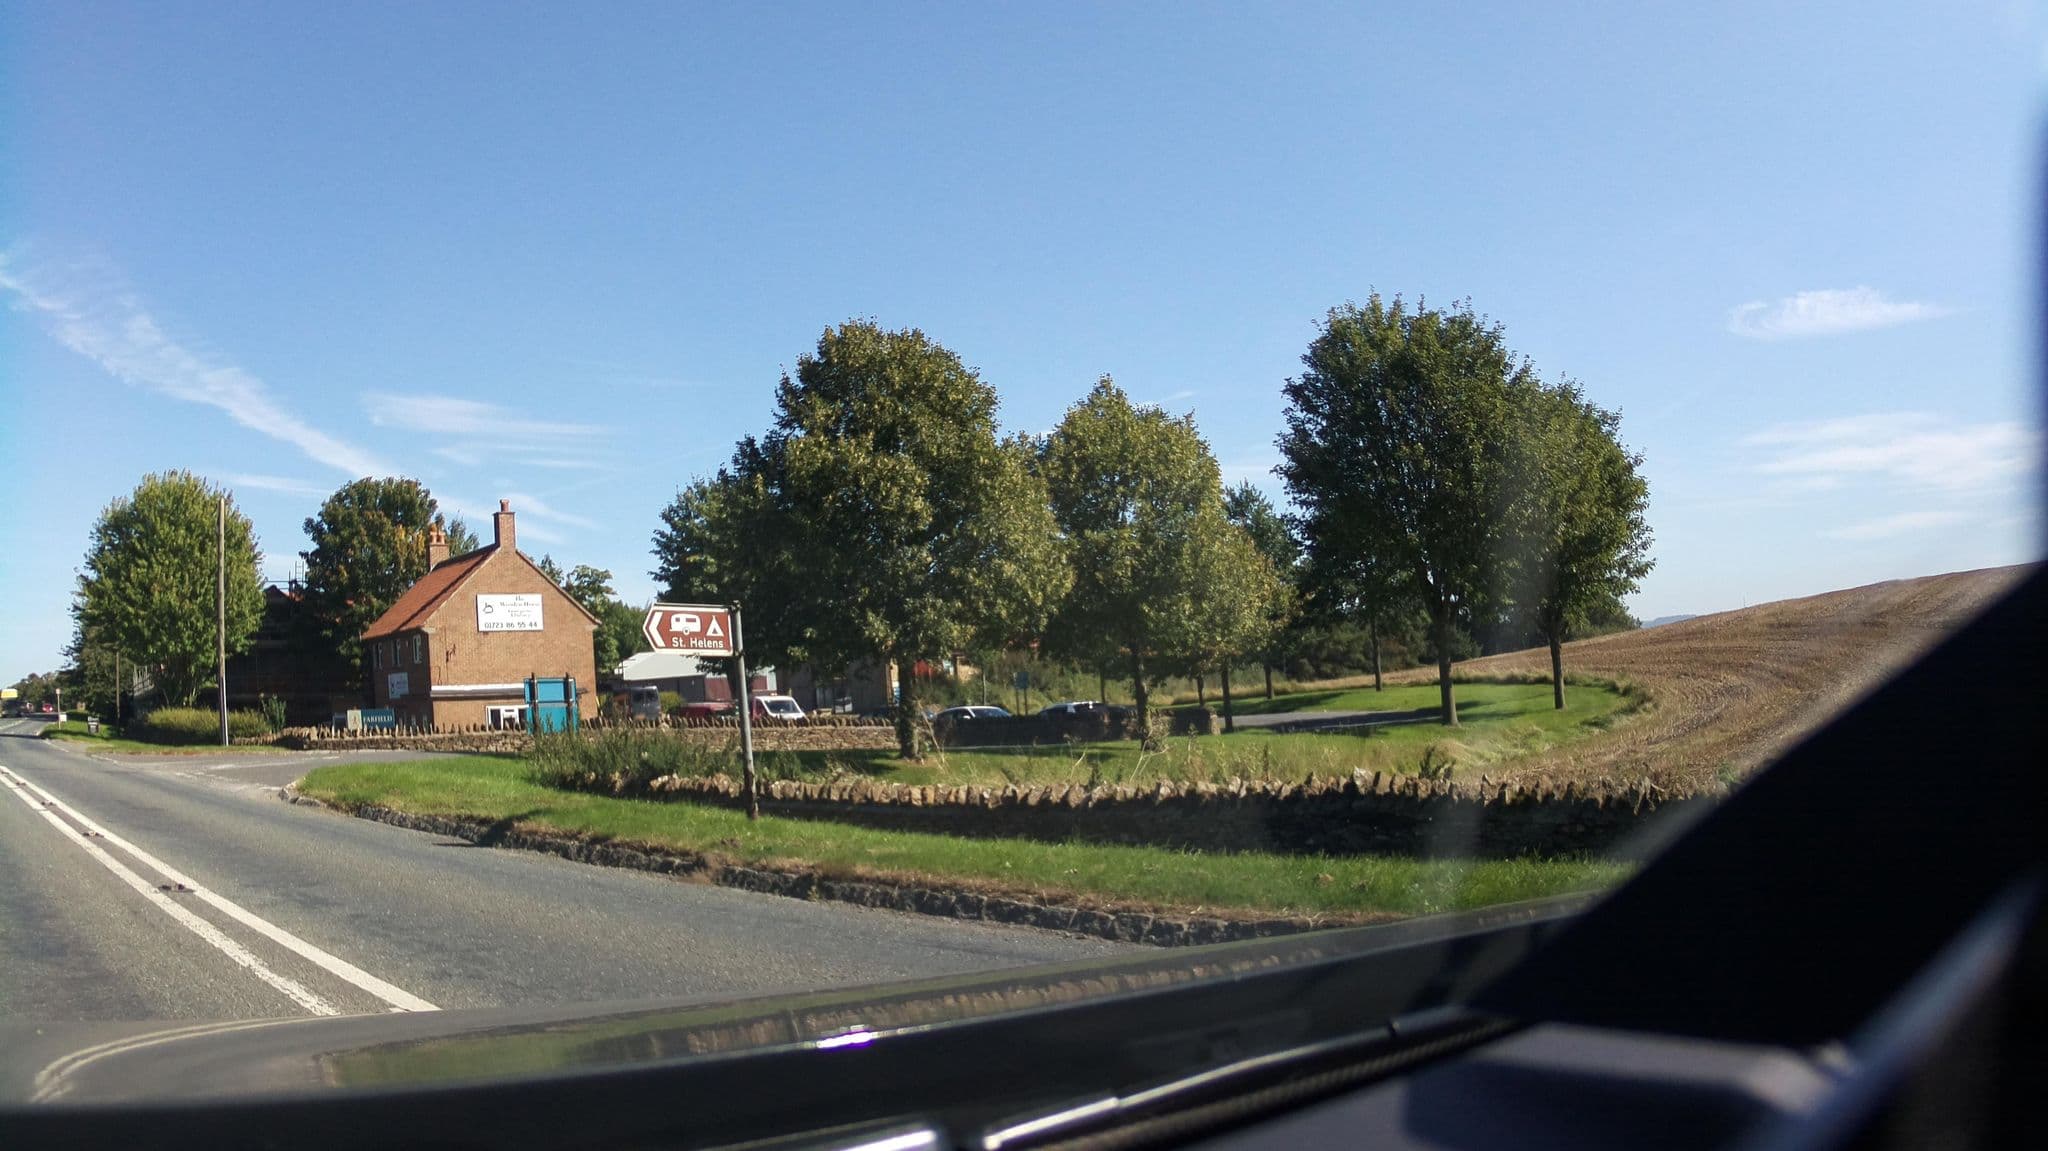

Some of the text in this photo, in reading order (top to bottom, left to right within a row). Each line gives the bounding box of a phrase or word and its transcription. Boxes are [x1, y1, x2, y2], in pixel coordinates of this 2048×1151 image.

[484, 621, 504, 629] 01723
[506, 621, 515, 629] 86
[671, 637, 724, 648] St. Helens
